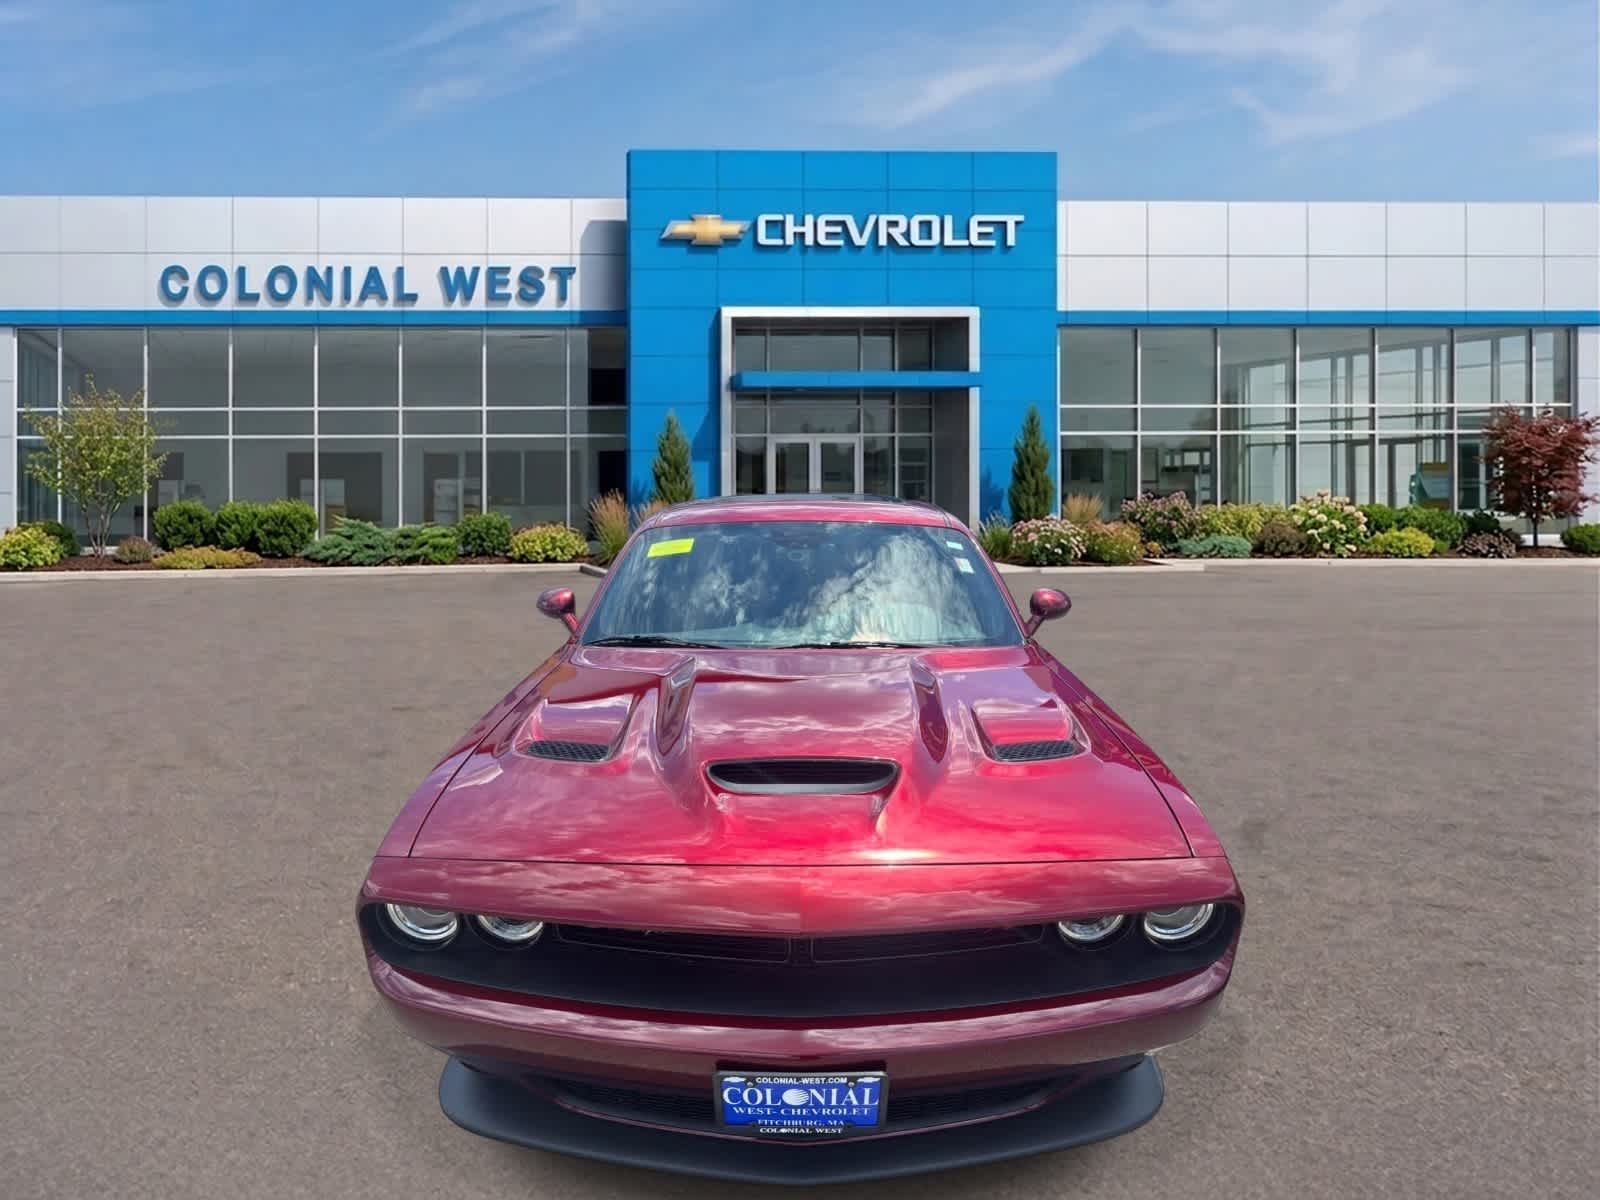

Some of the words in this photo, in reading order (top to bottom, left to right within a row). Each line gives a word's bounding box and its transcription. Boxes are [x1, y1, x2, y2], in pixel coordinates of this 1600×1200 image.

[757, 214, 1025, 247] CHEVROLET
[160, 265, 418, 303] COLONIAL
[439, 265, 577, 303] WEST
[755, 1077, 848, 1085] COLONIAL-WEST.COM
[722, 1087, 880, 1106] COLONIAL
[827, 1119, 845, 1127] MA
